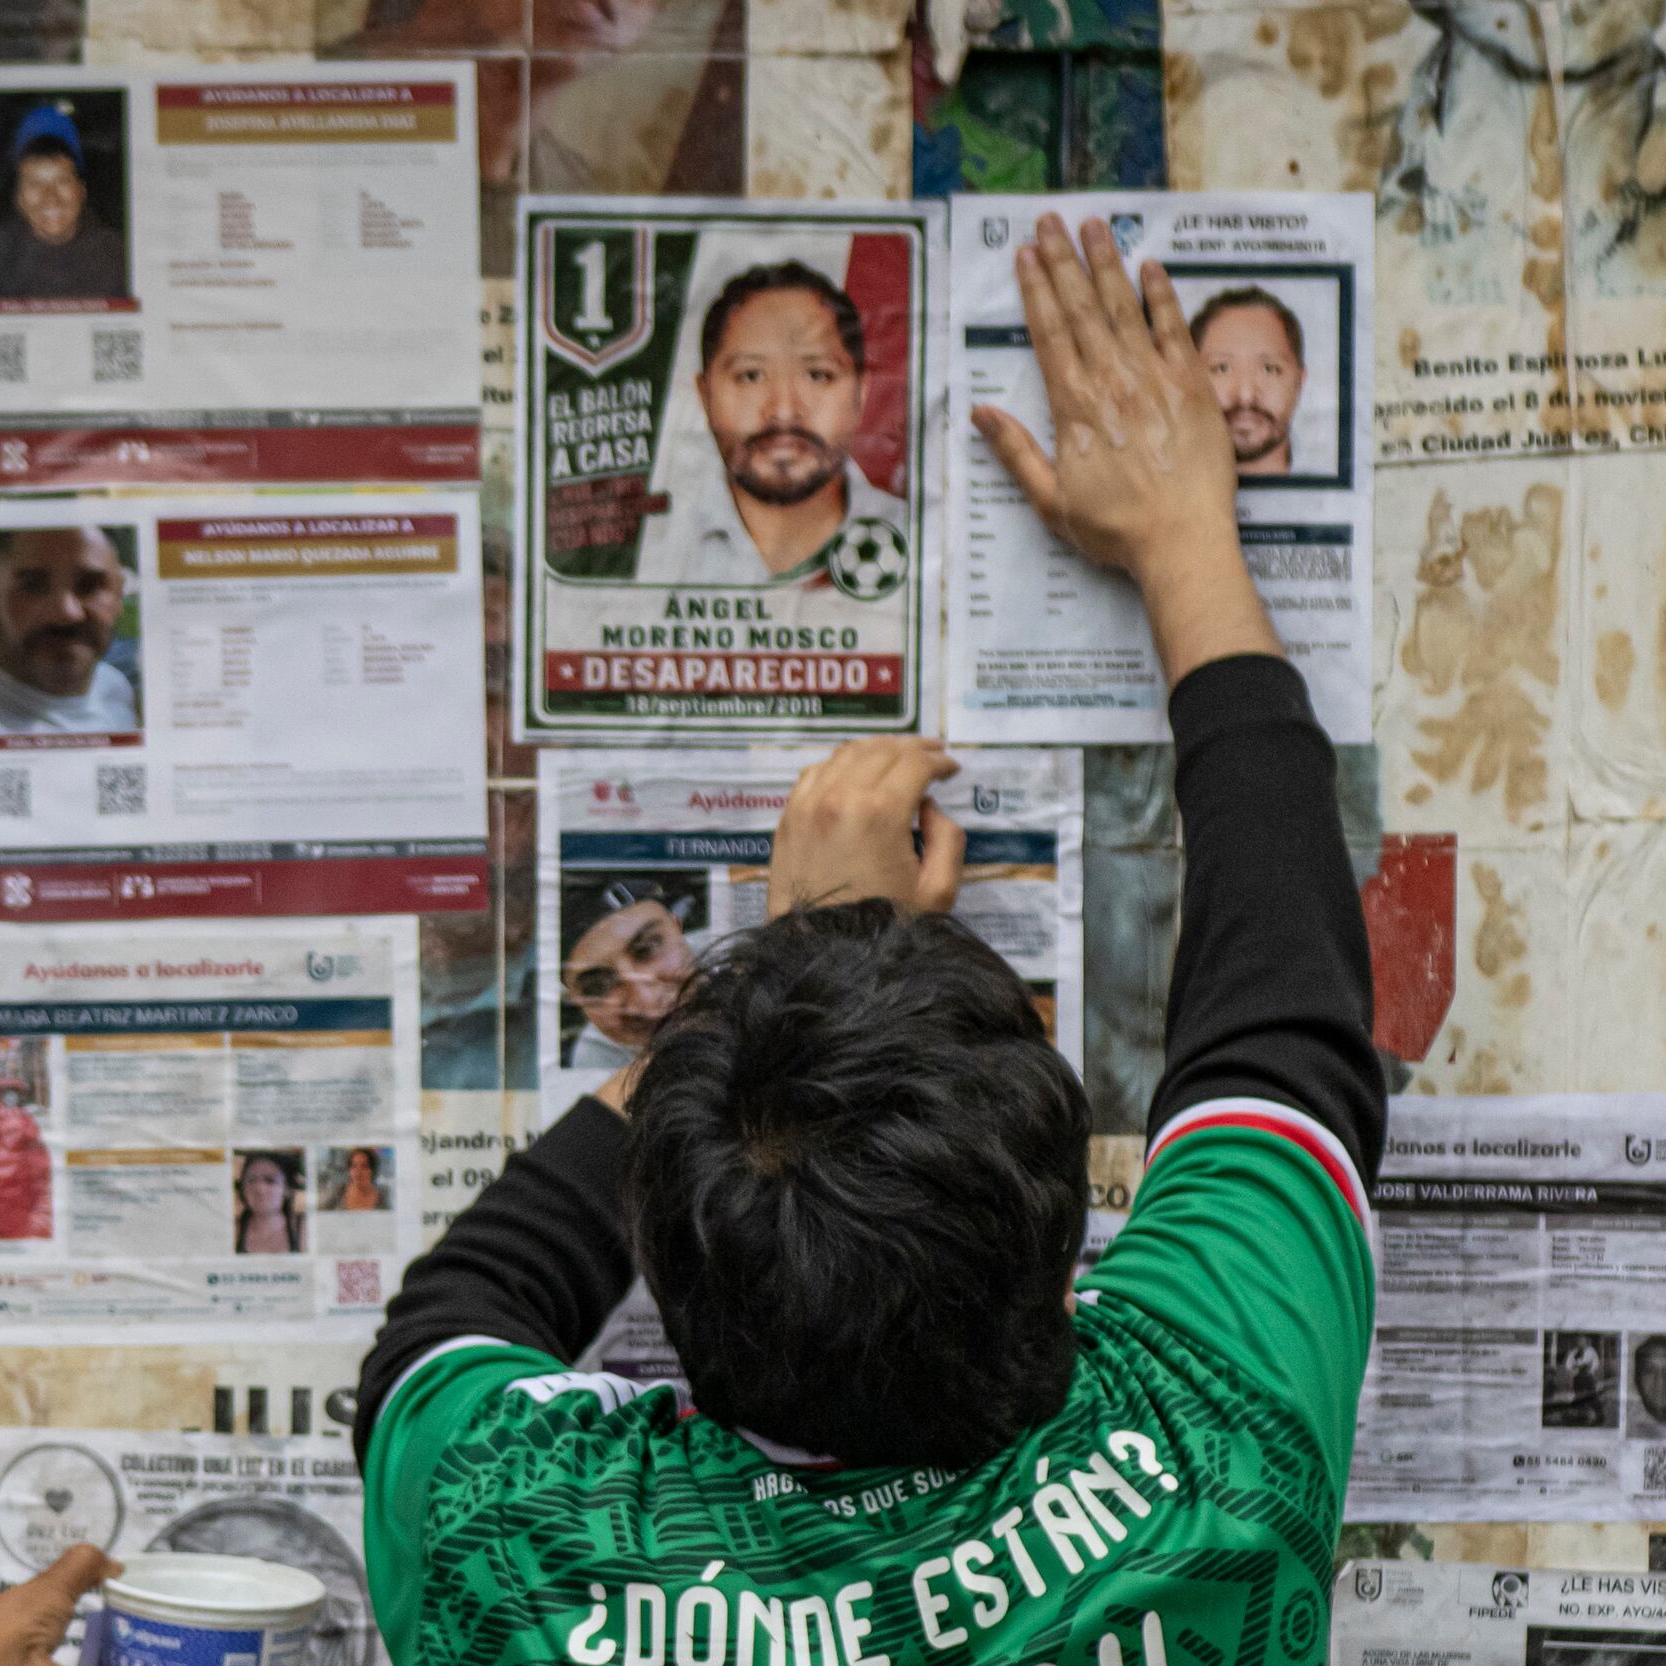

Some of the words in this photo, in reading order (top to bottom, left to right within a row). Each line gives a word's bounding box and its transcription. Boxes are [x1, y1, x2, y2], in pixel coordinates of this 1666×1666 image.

[572, 240, 614, 332] 1
[1414, 356, 1500, 378] Benito
[1508, 352, 1628, 376] Espinoza
[549, 391, 576, 420] EL
[551, 414, 652, 448] REGRESA
[551, 448, 573, 478] A
[577, 439, 651, 473] CASA
[664, 592, 773, 620] ÁNGEL
[602, 625, 736, 650] MORENO
[749, 626, 859, 650] MOSCO
[583, 656, 869, 690] DESAPARECIDO
[913, 1429, 1184, 1651] ESTÁN?
[1560, 1578, 1592, 1596] ¿LE
[1598, 1577, 1634, 1595] HAS
